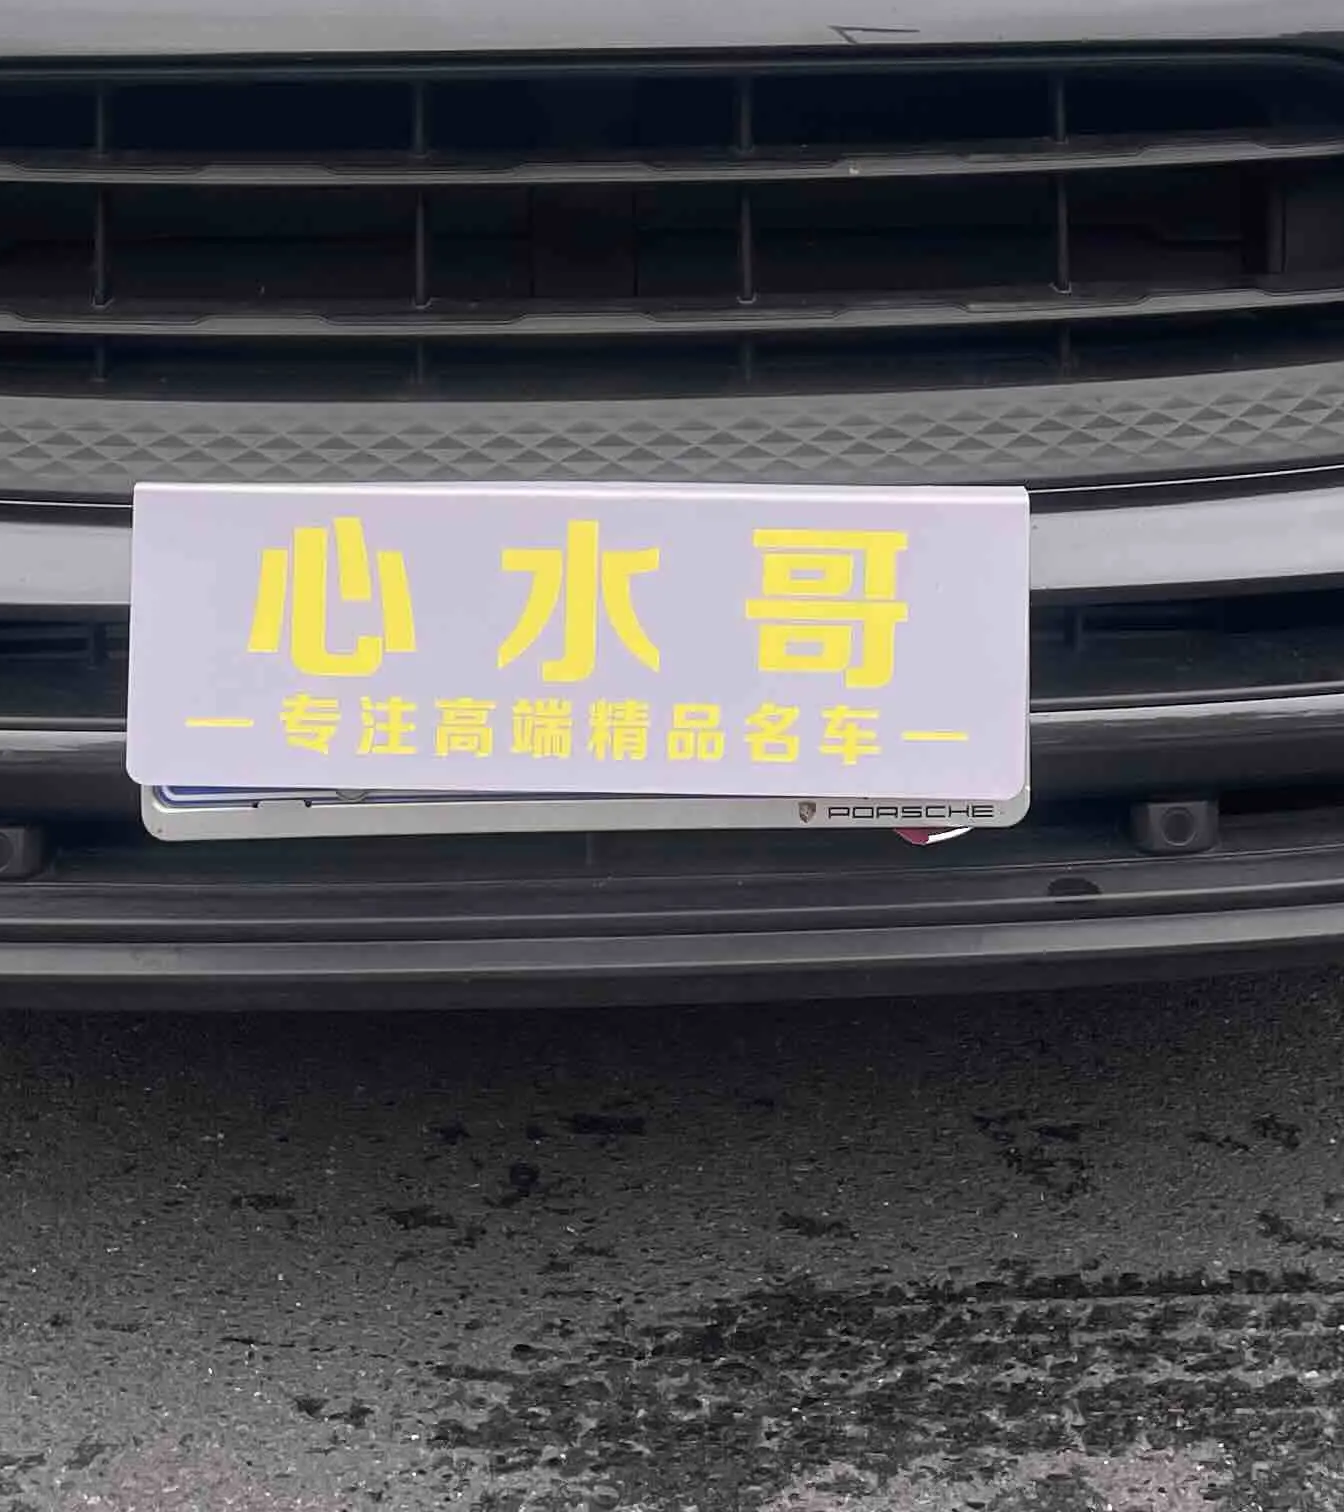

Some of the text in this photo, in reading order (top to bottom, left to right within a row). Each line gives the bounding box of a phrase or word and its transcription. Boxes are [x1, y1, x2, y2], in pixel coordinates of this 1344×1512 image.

[248, 516, 909, 689] 心水哥
[278, 693, 884, 766] 专注高端精品名车
[827, 805, 996, 820] PORSCHE
